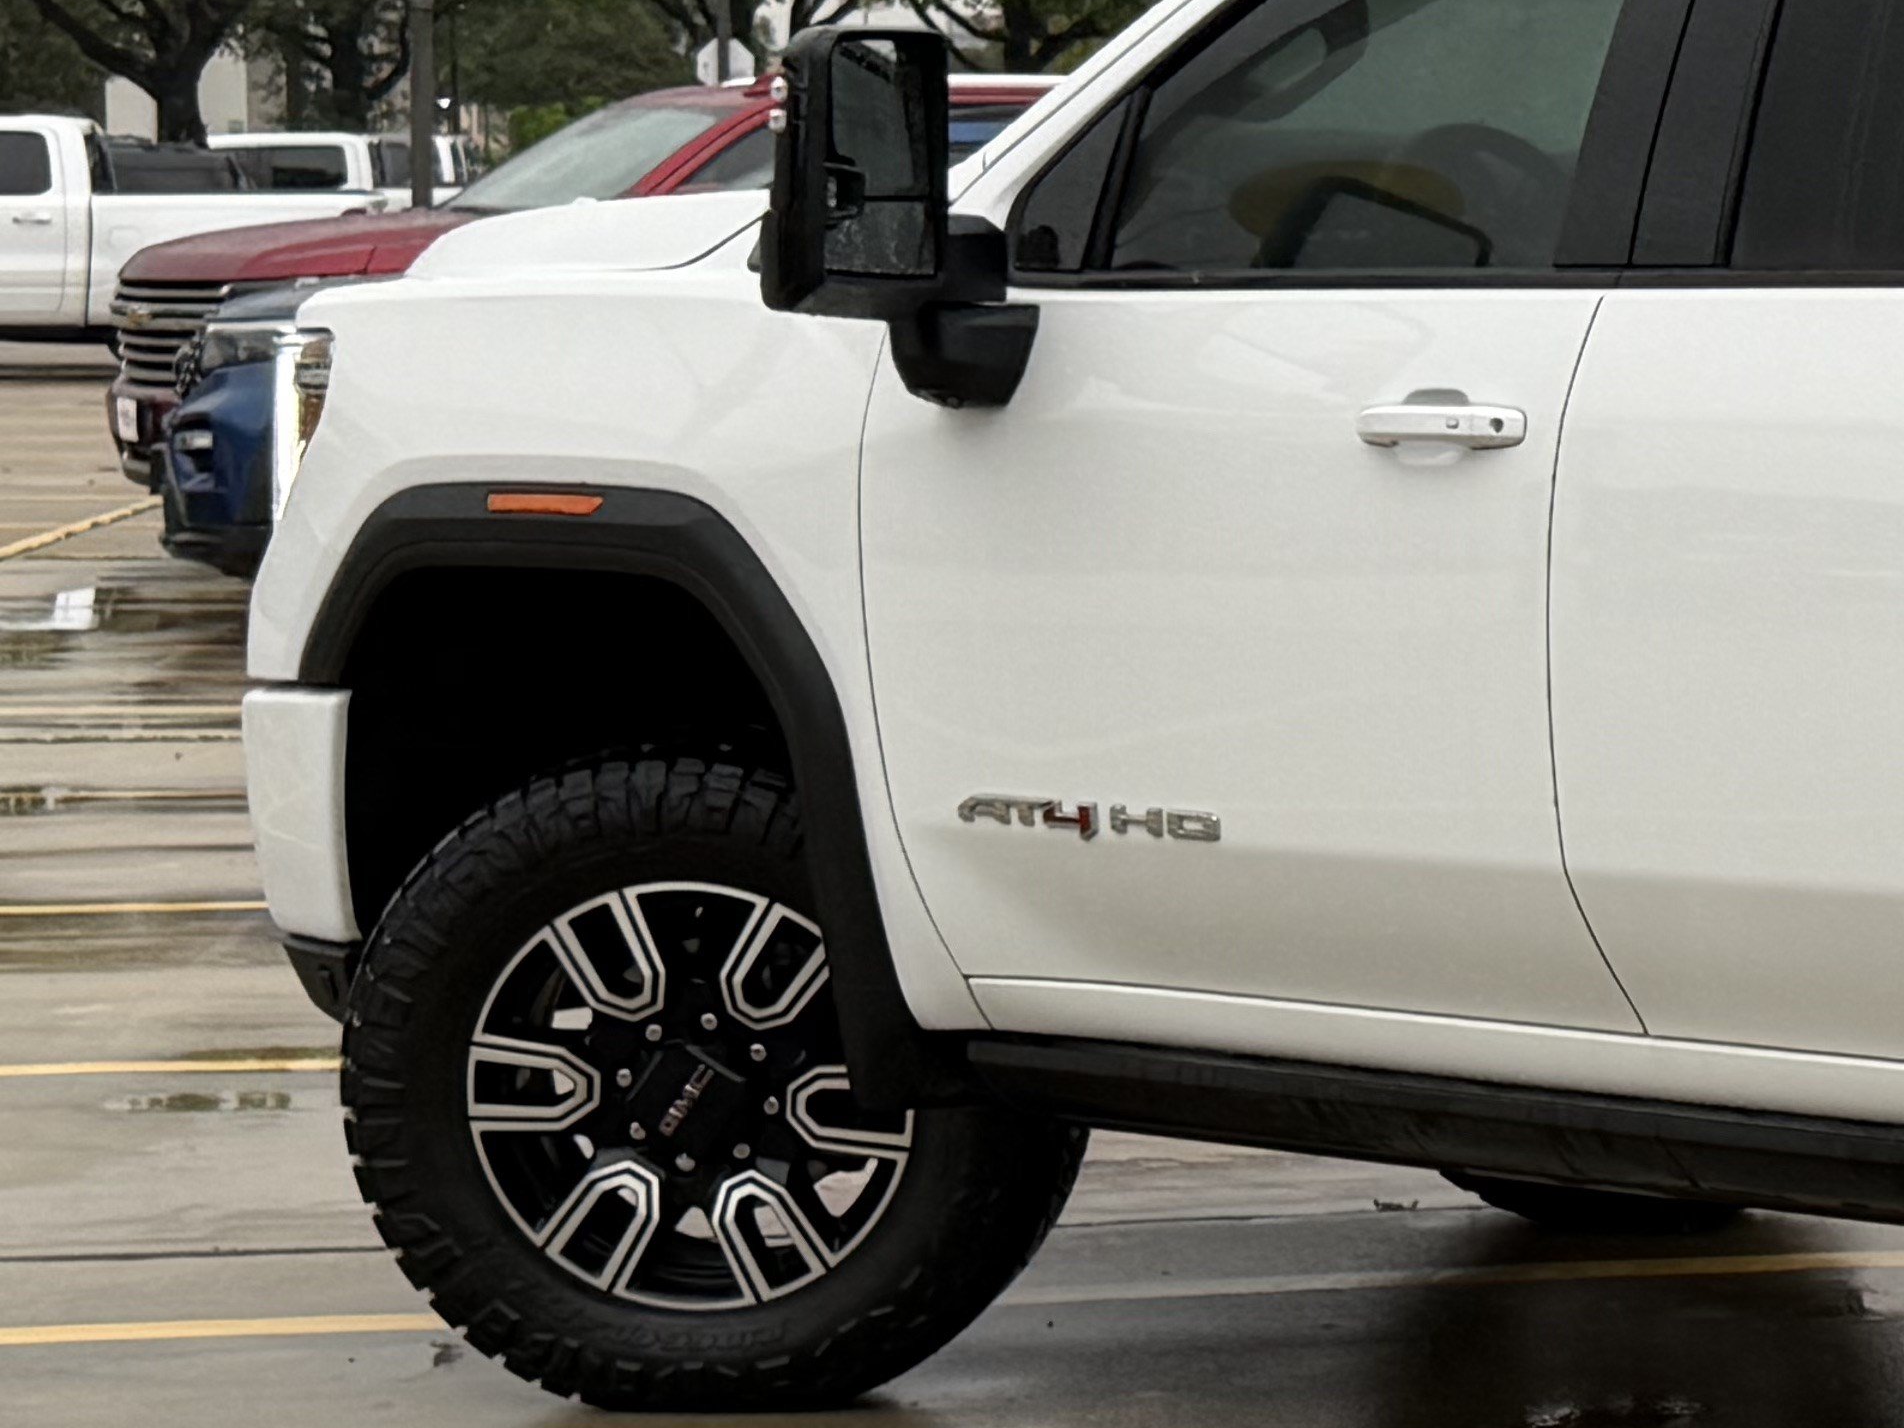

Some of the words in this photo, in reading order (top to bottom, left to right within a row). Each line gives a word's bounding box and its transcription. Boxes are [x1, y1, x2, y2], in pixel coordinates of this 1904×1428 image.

[957, 793, 1099, 842] AT4
[1109, 803, 1222, 842] HD
[658, 1063, 715, 1137] GMC
